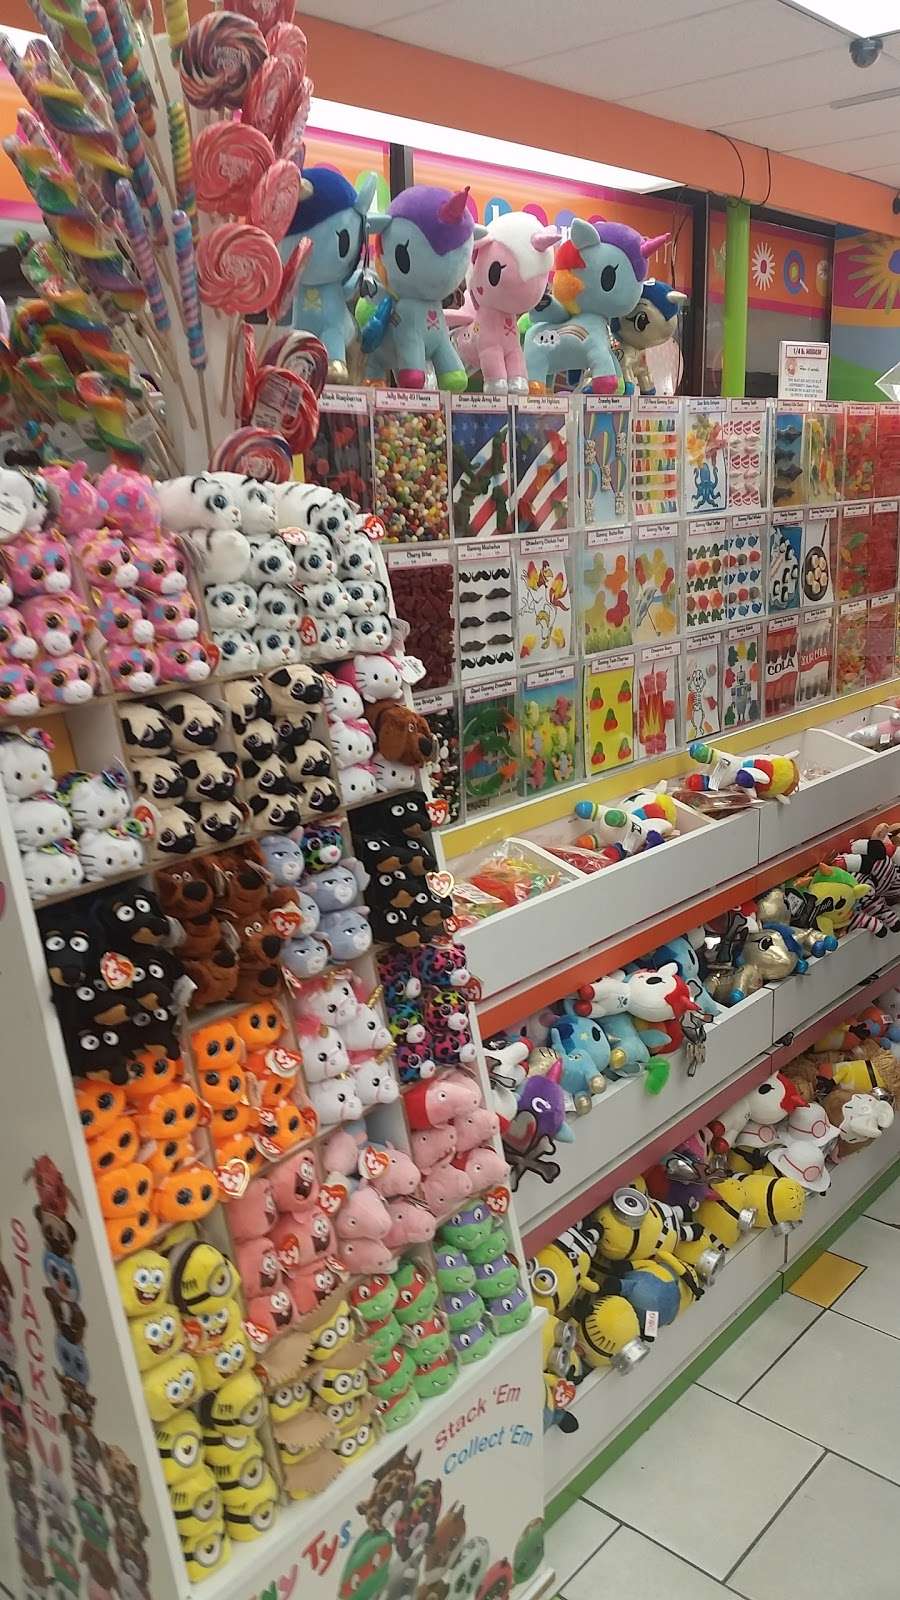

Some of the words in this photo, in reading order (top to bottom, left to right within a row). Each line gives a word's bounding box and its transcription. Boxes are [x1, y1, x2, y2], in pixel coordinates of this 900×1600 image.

[767, 658, 794, 676] COLA
[10, 1217, 50, 1400] STACK
[434, 1400, 486, 1451] Stack
[443, 1428, 505, 1475] Collect
